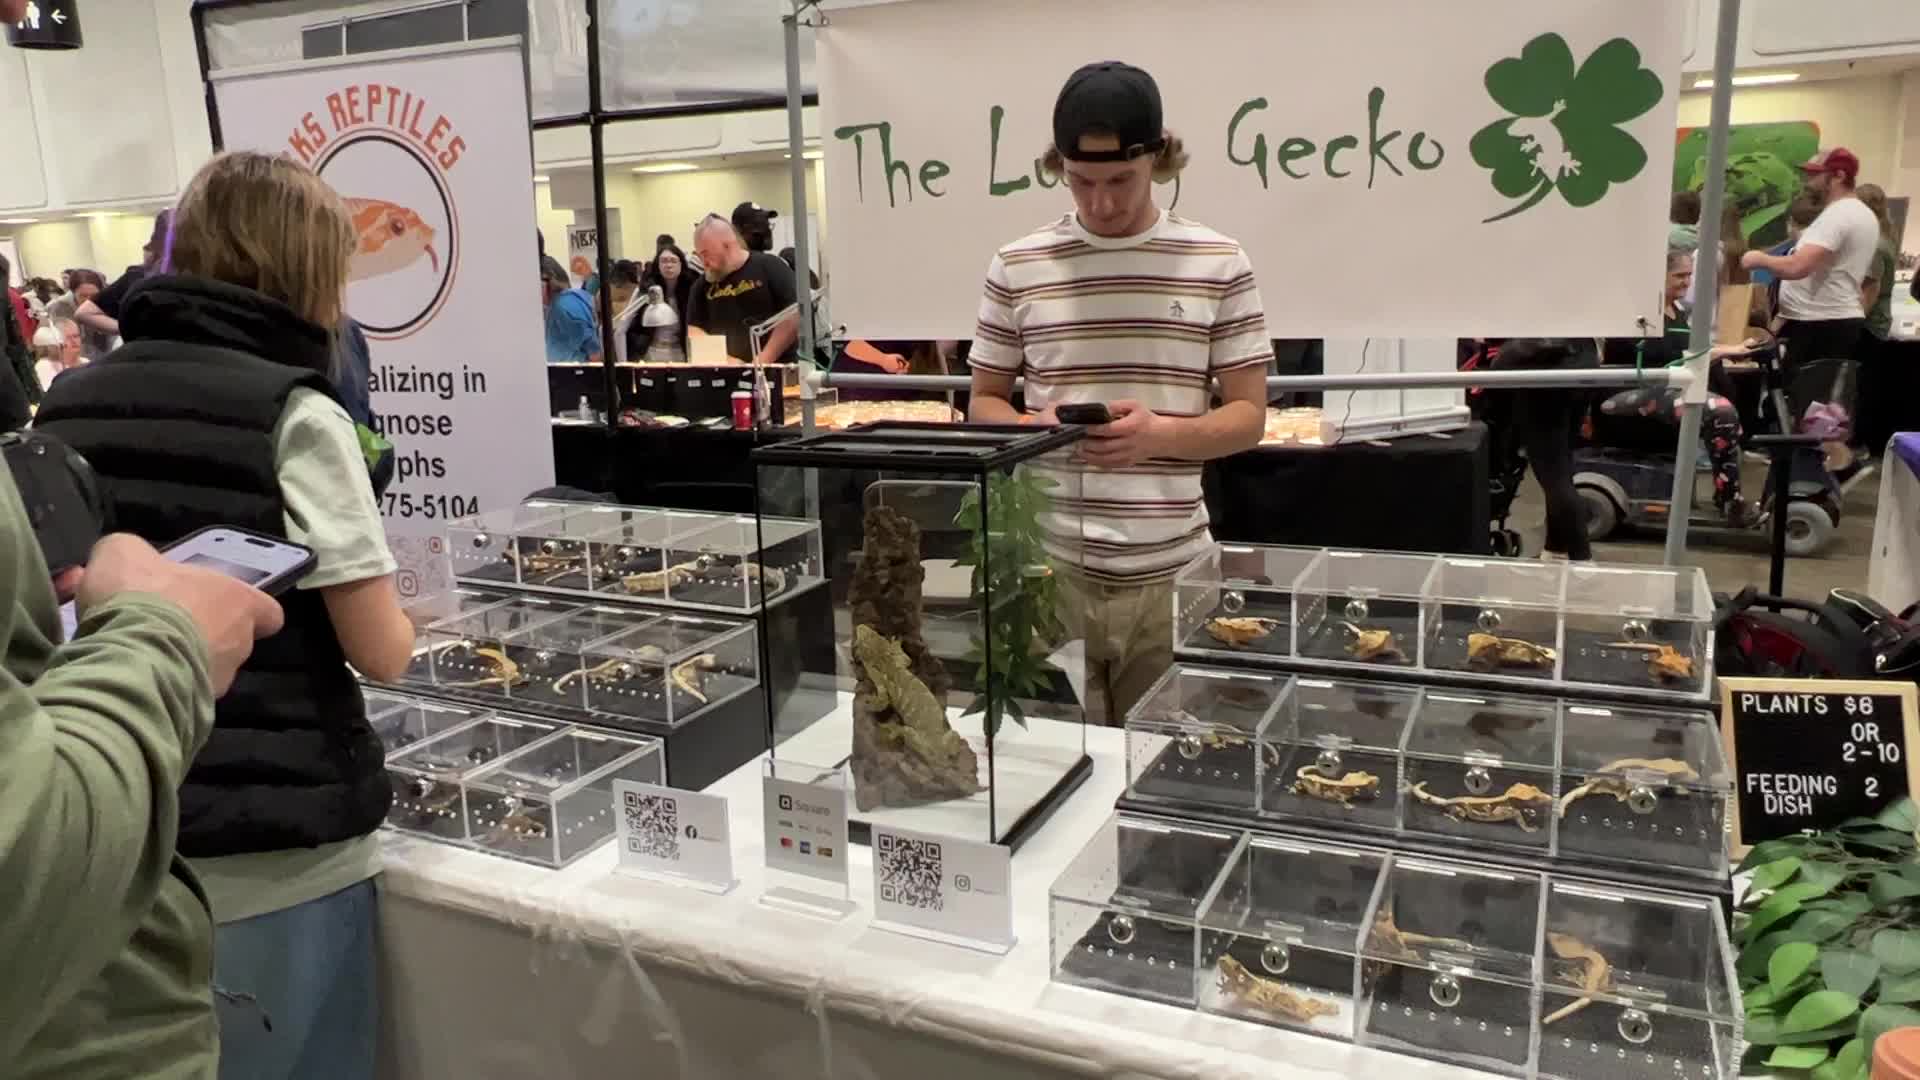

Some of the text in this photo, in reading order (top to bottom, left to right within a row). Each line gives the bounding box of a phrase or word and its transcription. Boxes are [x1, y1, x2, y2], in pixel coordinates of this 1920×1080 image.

[283, 84, 466, 170] KS REPTILES
[834, 121, 950, 208] The
[1227, 86, 1444, 190] Gecko
[368, 364, 486, 400] alizing in
[374, 413, 453, 439] gnose
[398, 450, 446, 483] phs
[1741, 693, 1873, 715] PLANTS $6
[1851, 722, 1880, 742] OR
[1746, 774, 1879, 797] FEEDING 2
[1764, 794, 1812, 815] DISH
